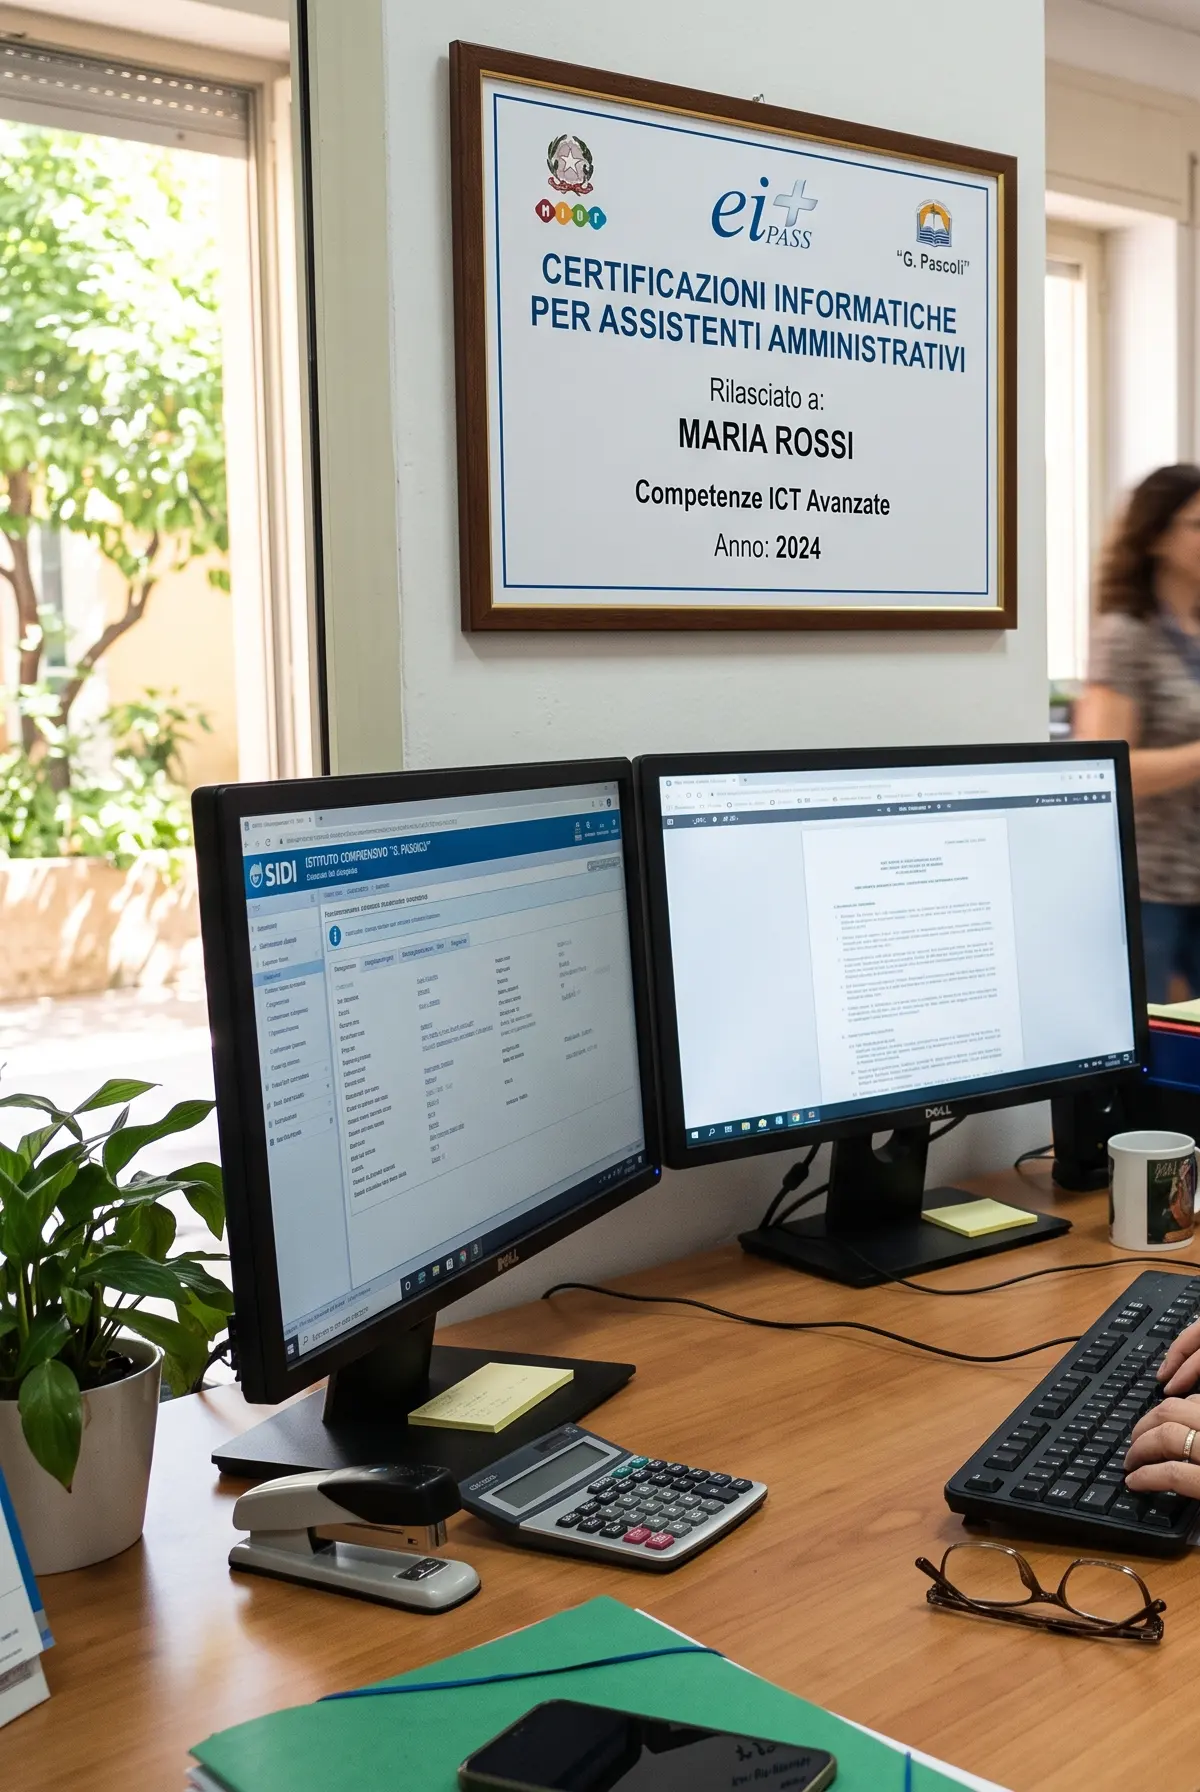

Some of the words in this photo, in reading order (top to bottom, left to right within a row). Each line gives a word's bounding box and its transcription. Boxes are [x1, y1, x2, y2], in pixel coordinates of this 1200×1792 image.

[765, 225, 813, 250] PASS
[541, 252, 766, 310] CERTIFICAZIONI
[774, 283, 957, 335] INFORMATICHE
[531, 294, 592, 332] PER
[598, 303, 761, 351] ASSISTENTI
[767, 324, 965, 373] AMMINISTRATIVI
[710, 376, 802, 409] Rilasciato
[808, 391, 824, 411] a:
[678, 417, 768, 454] MARIA
[775, 425, 853, 460] ROSSI
[635, 478, 763, 512] Competenze
[769, 486, 802, 511] ICT
[805, 489, 891, 516] Avanzate
[713, 532, 769, 558] Anno:
[775, 535, 821, 560] 2024
[265, 859, 298, 887] SIDI
